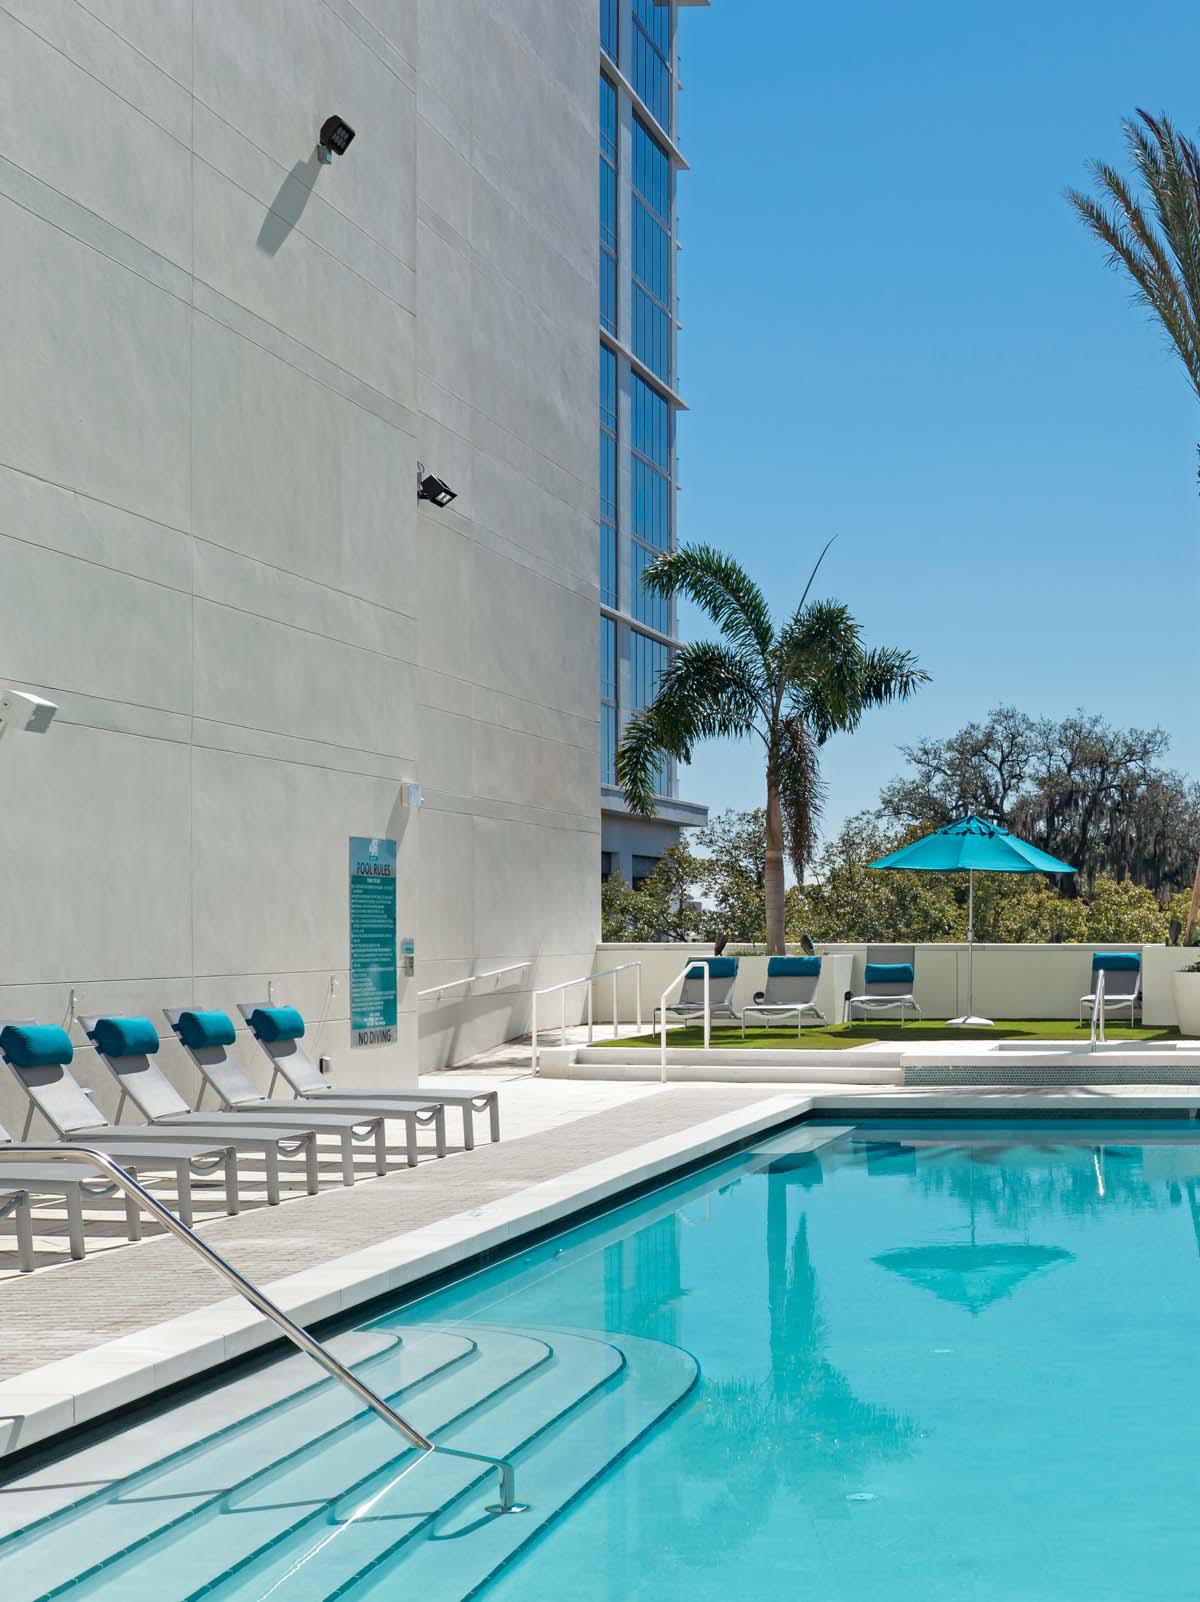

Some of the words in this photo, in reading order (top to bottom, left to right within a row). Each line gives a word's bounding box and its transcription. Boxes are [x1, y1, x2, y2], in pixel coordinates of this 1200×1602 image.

[357, 862, 373, 875] POOL
[374, 863, 391, 876] RULES
[358, 1031, 369, 1046] NO
[369, 1029, 391, 1044] DIVING
